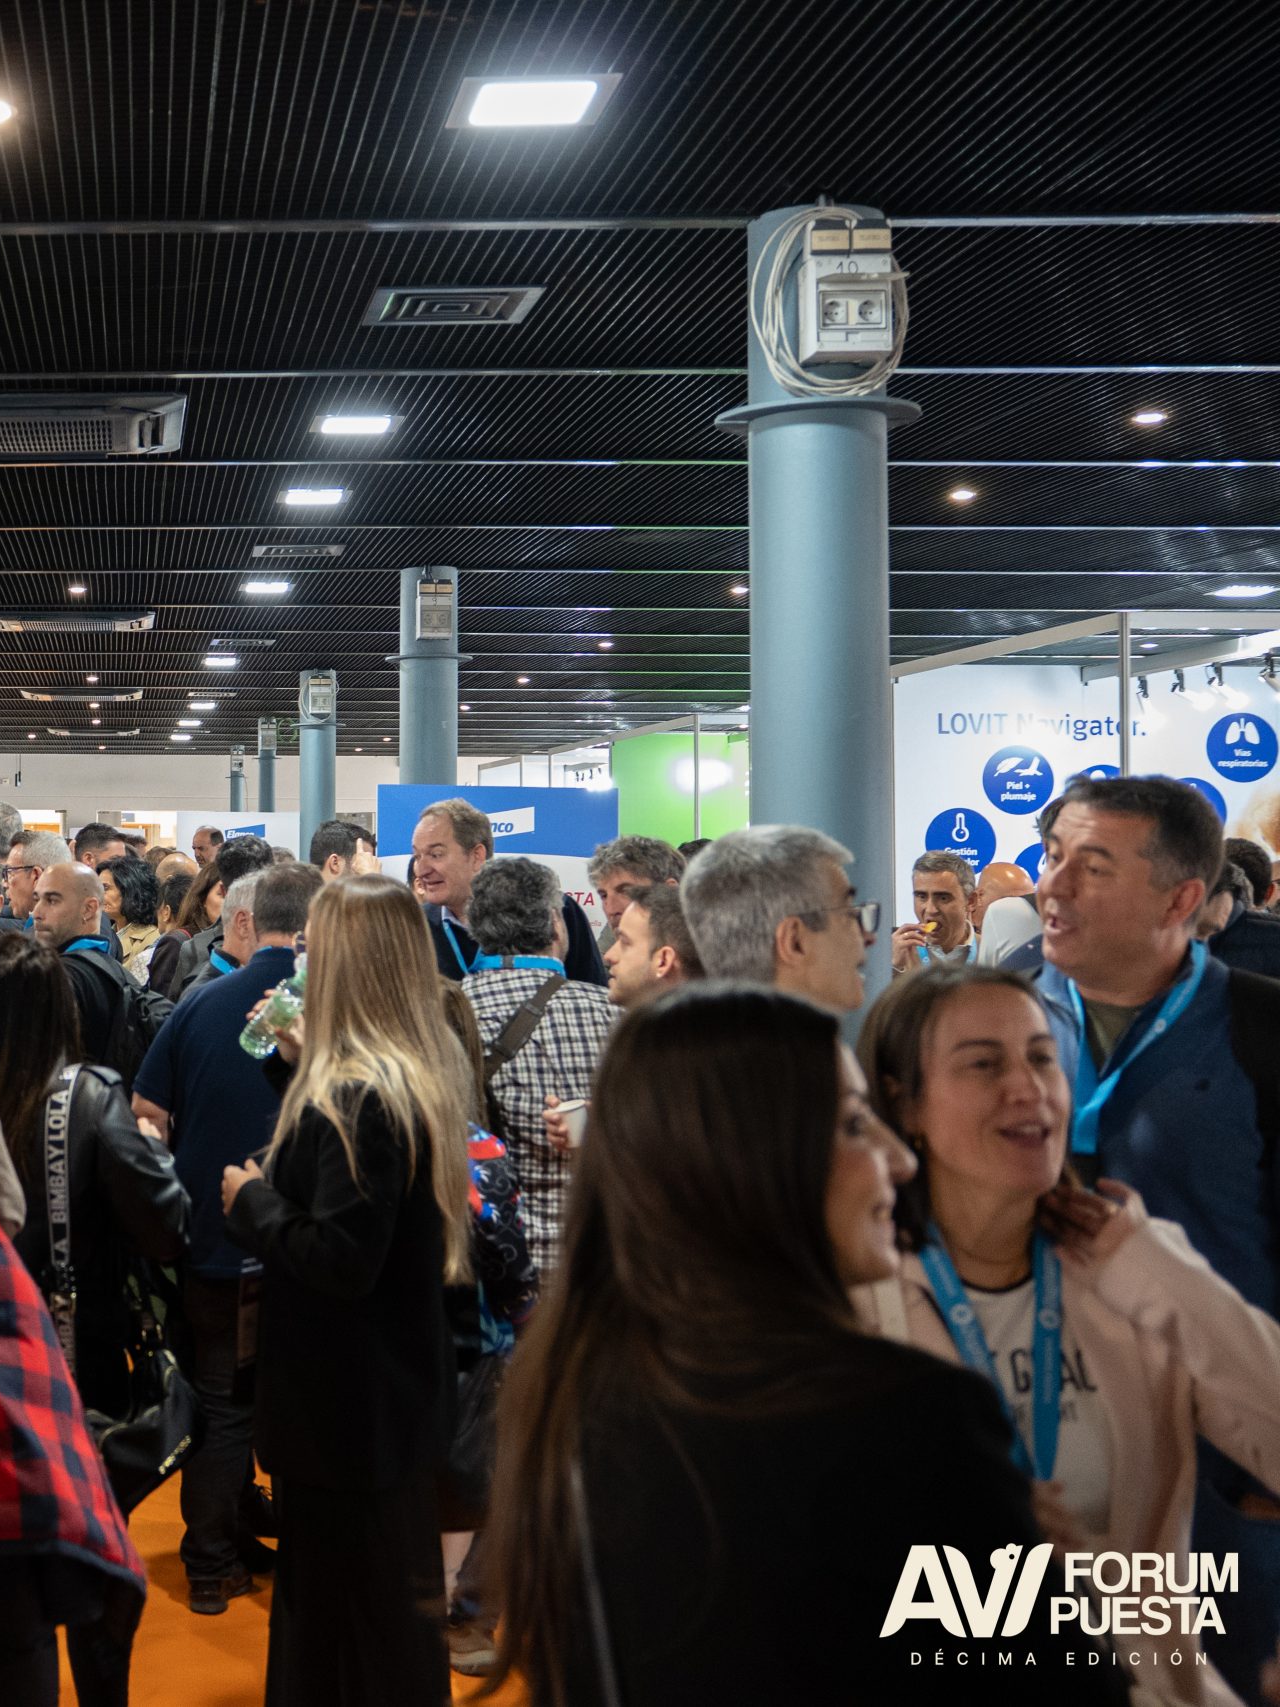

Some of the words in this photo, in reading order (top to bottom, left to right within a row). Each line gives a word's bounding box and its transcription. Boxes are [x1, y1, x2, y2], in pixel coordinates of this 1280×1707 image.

[937, 712, 1009, 735] LOVIT
[1006, 781, 1023, 790] Piel
[1000, 791, 1037, 802] plumaje
